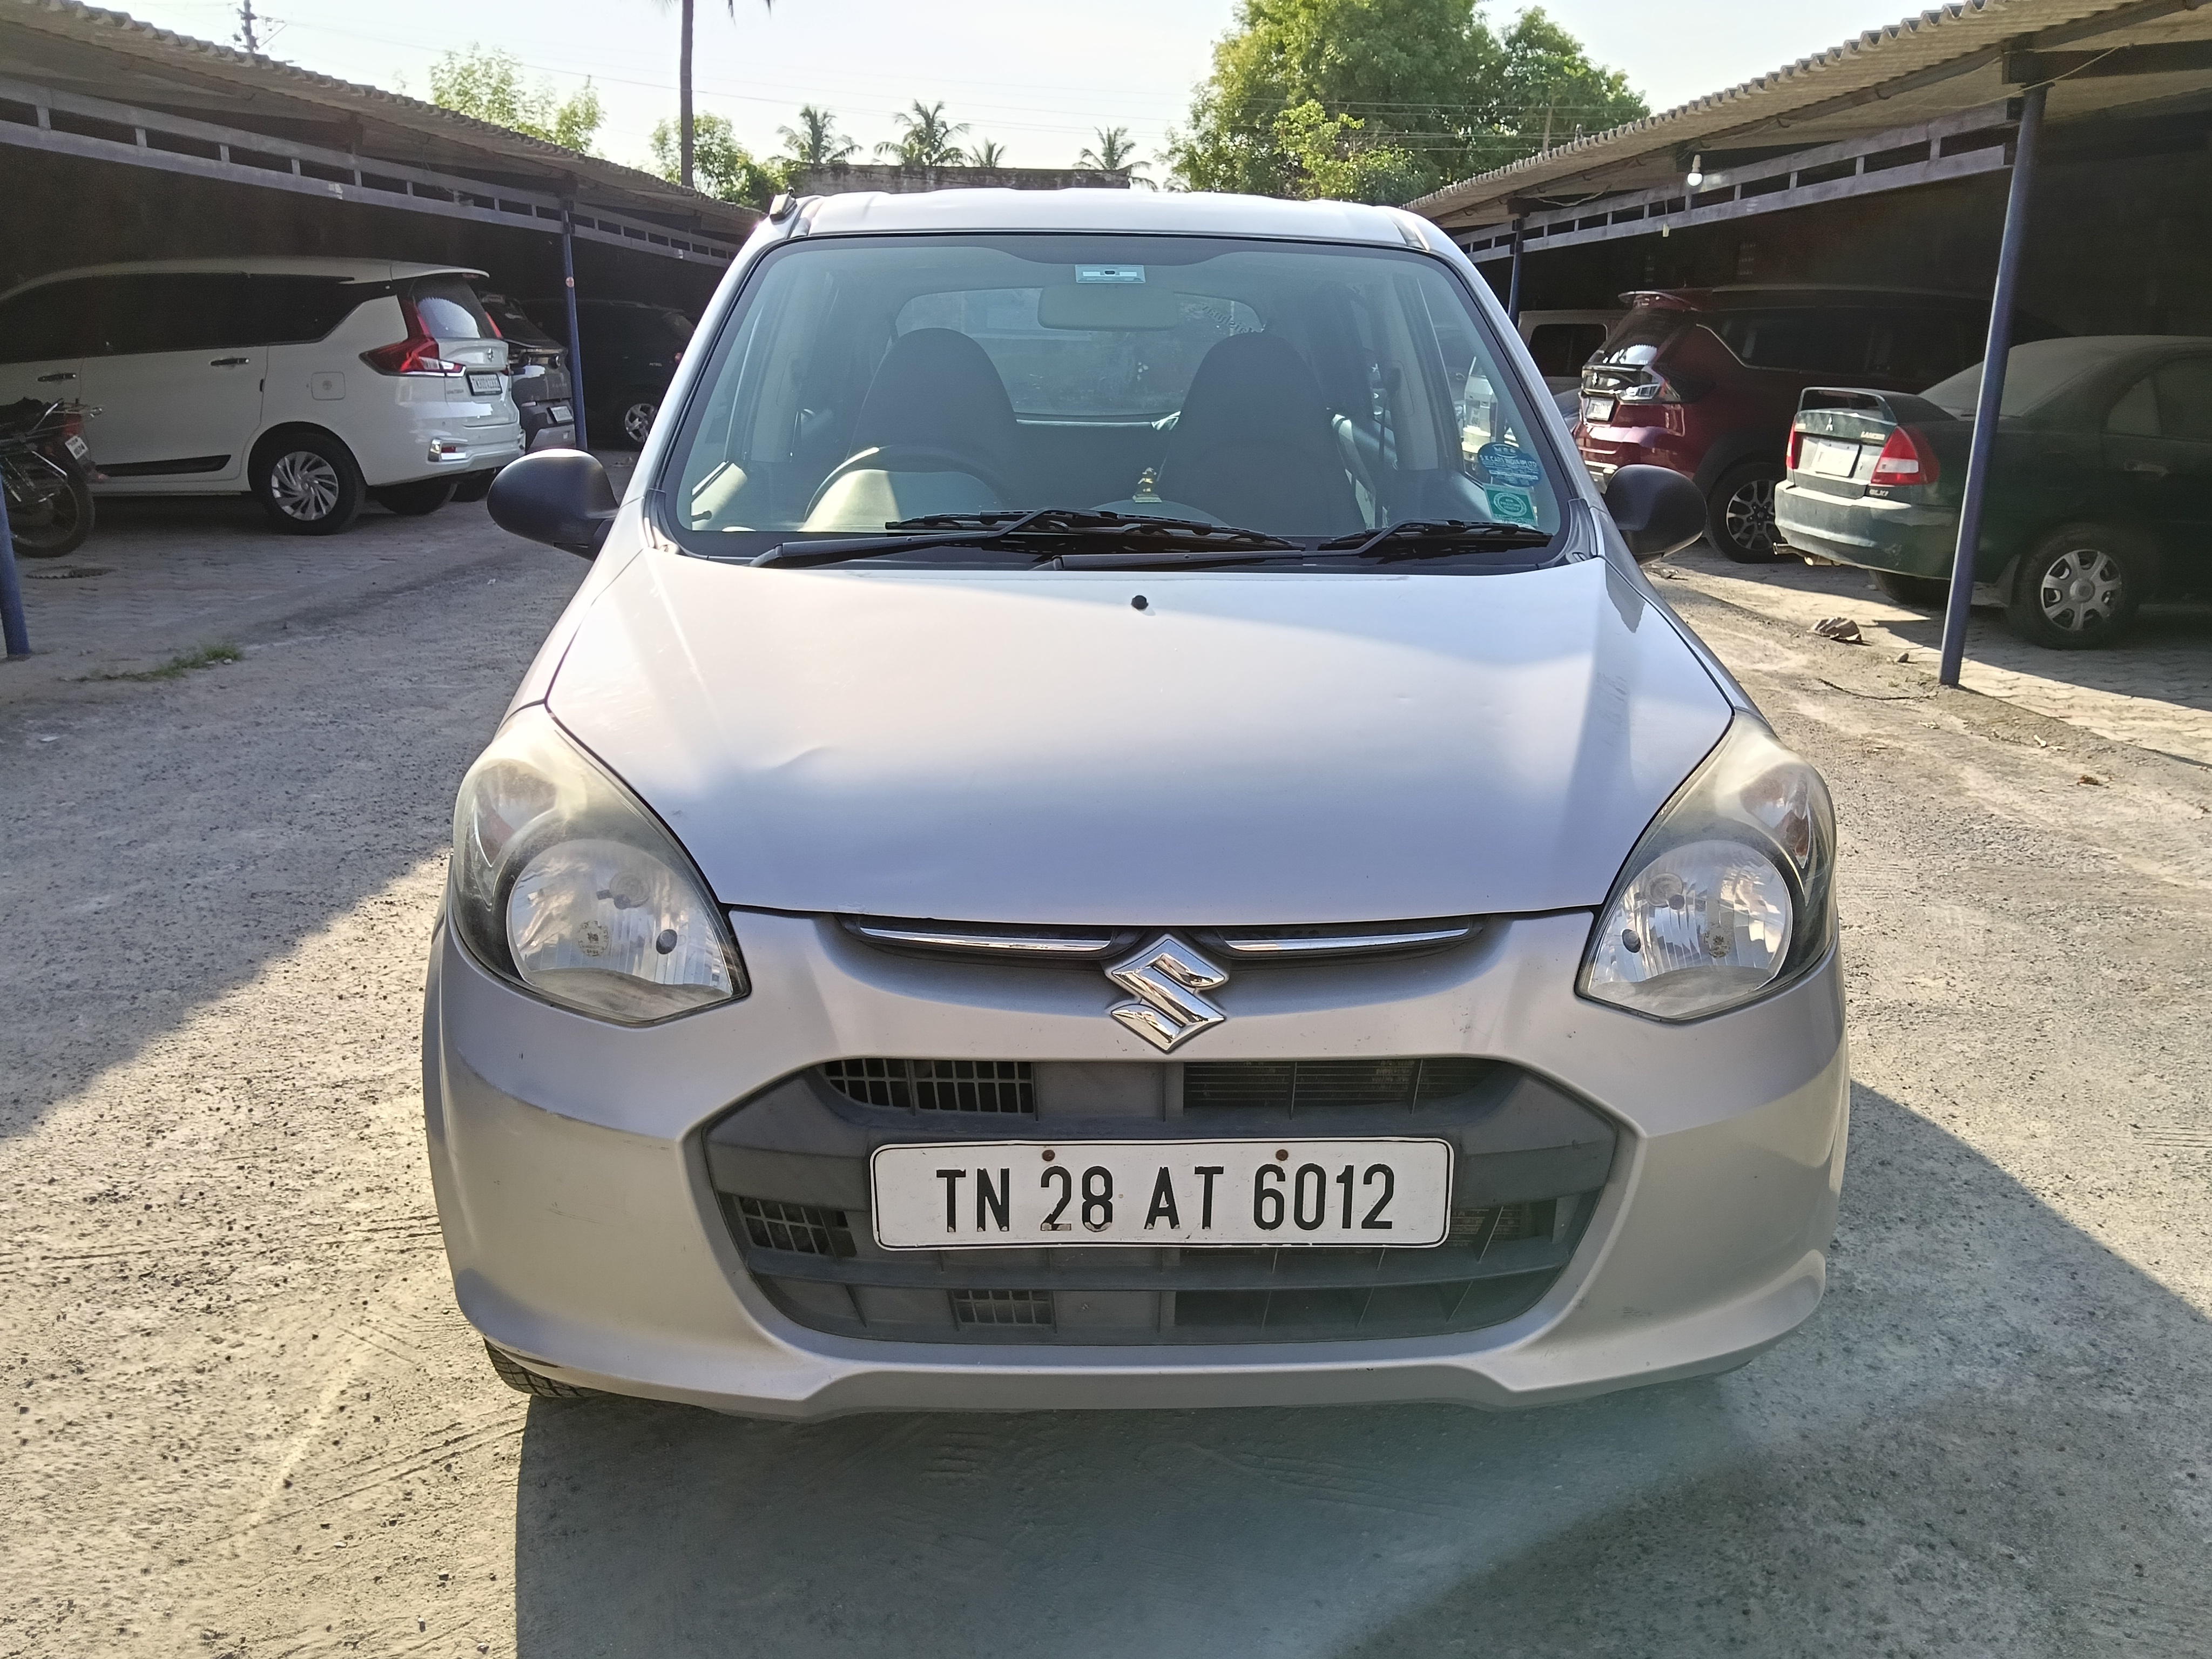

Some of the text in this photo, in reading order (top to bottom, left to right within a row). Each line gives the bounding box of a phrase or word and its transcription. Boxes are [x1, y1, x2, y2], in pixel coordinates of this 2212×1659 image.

[936, 1163, 1394, 1233] TN 28 AT 6012
